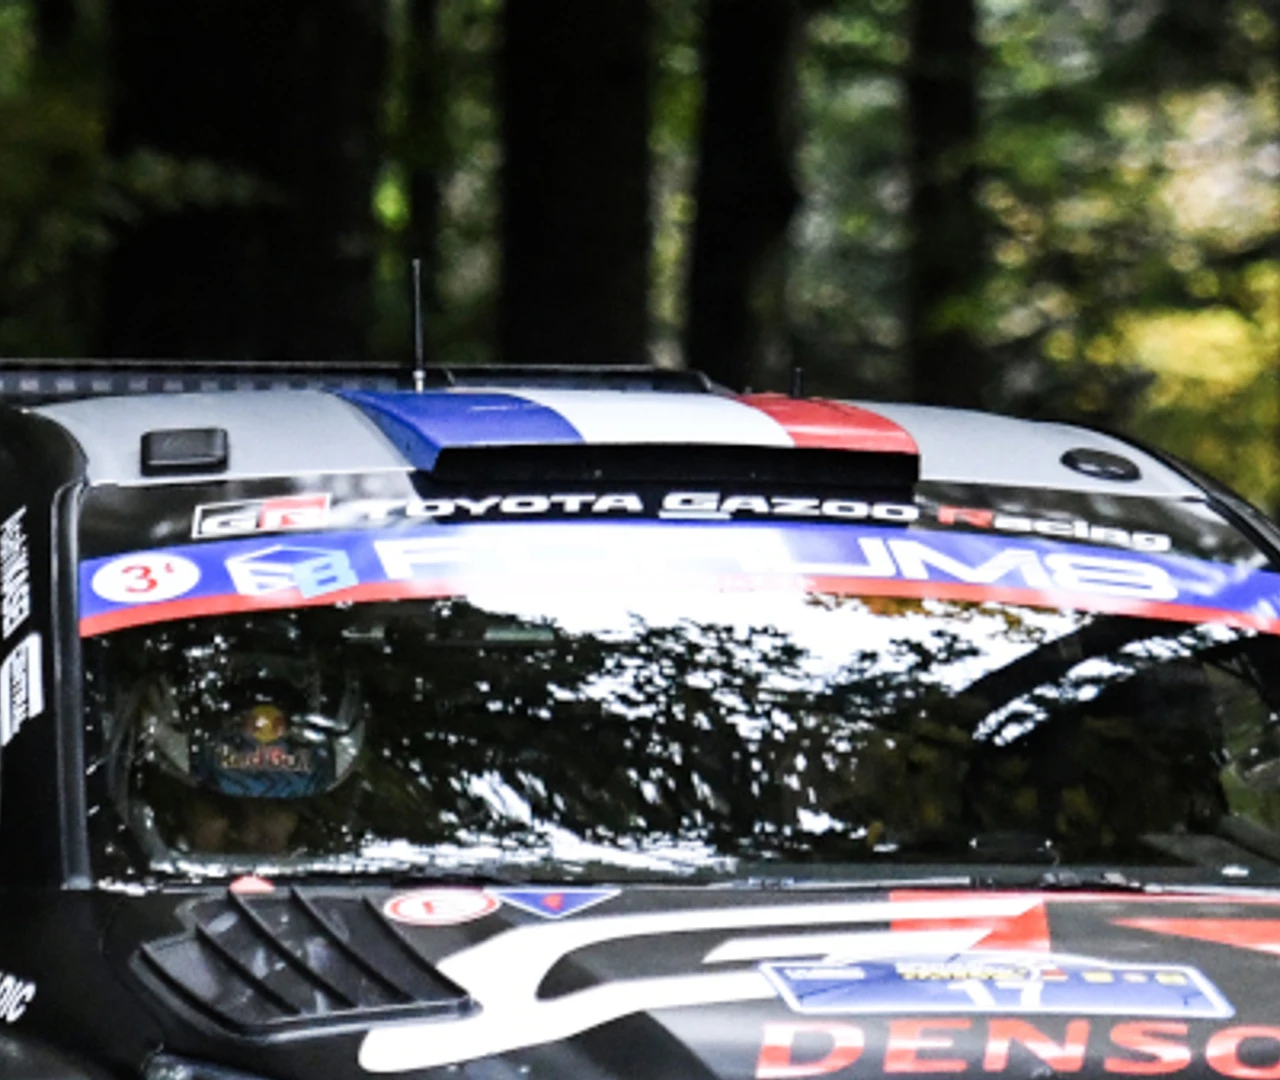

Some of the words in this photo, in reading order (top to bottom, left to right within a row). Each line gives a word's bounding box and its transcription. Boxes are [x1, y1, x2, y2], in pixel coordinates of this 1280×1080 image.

[361, 493, 644, 519] TOYOTA
[658, 492, 918, 521] GAZOO
[937, 505, 1171, 552] Racing
[373, 530, 1178, 601] FUM8
